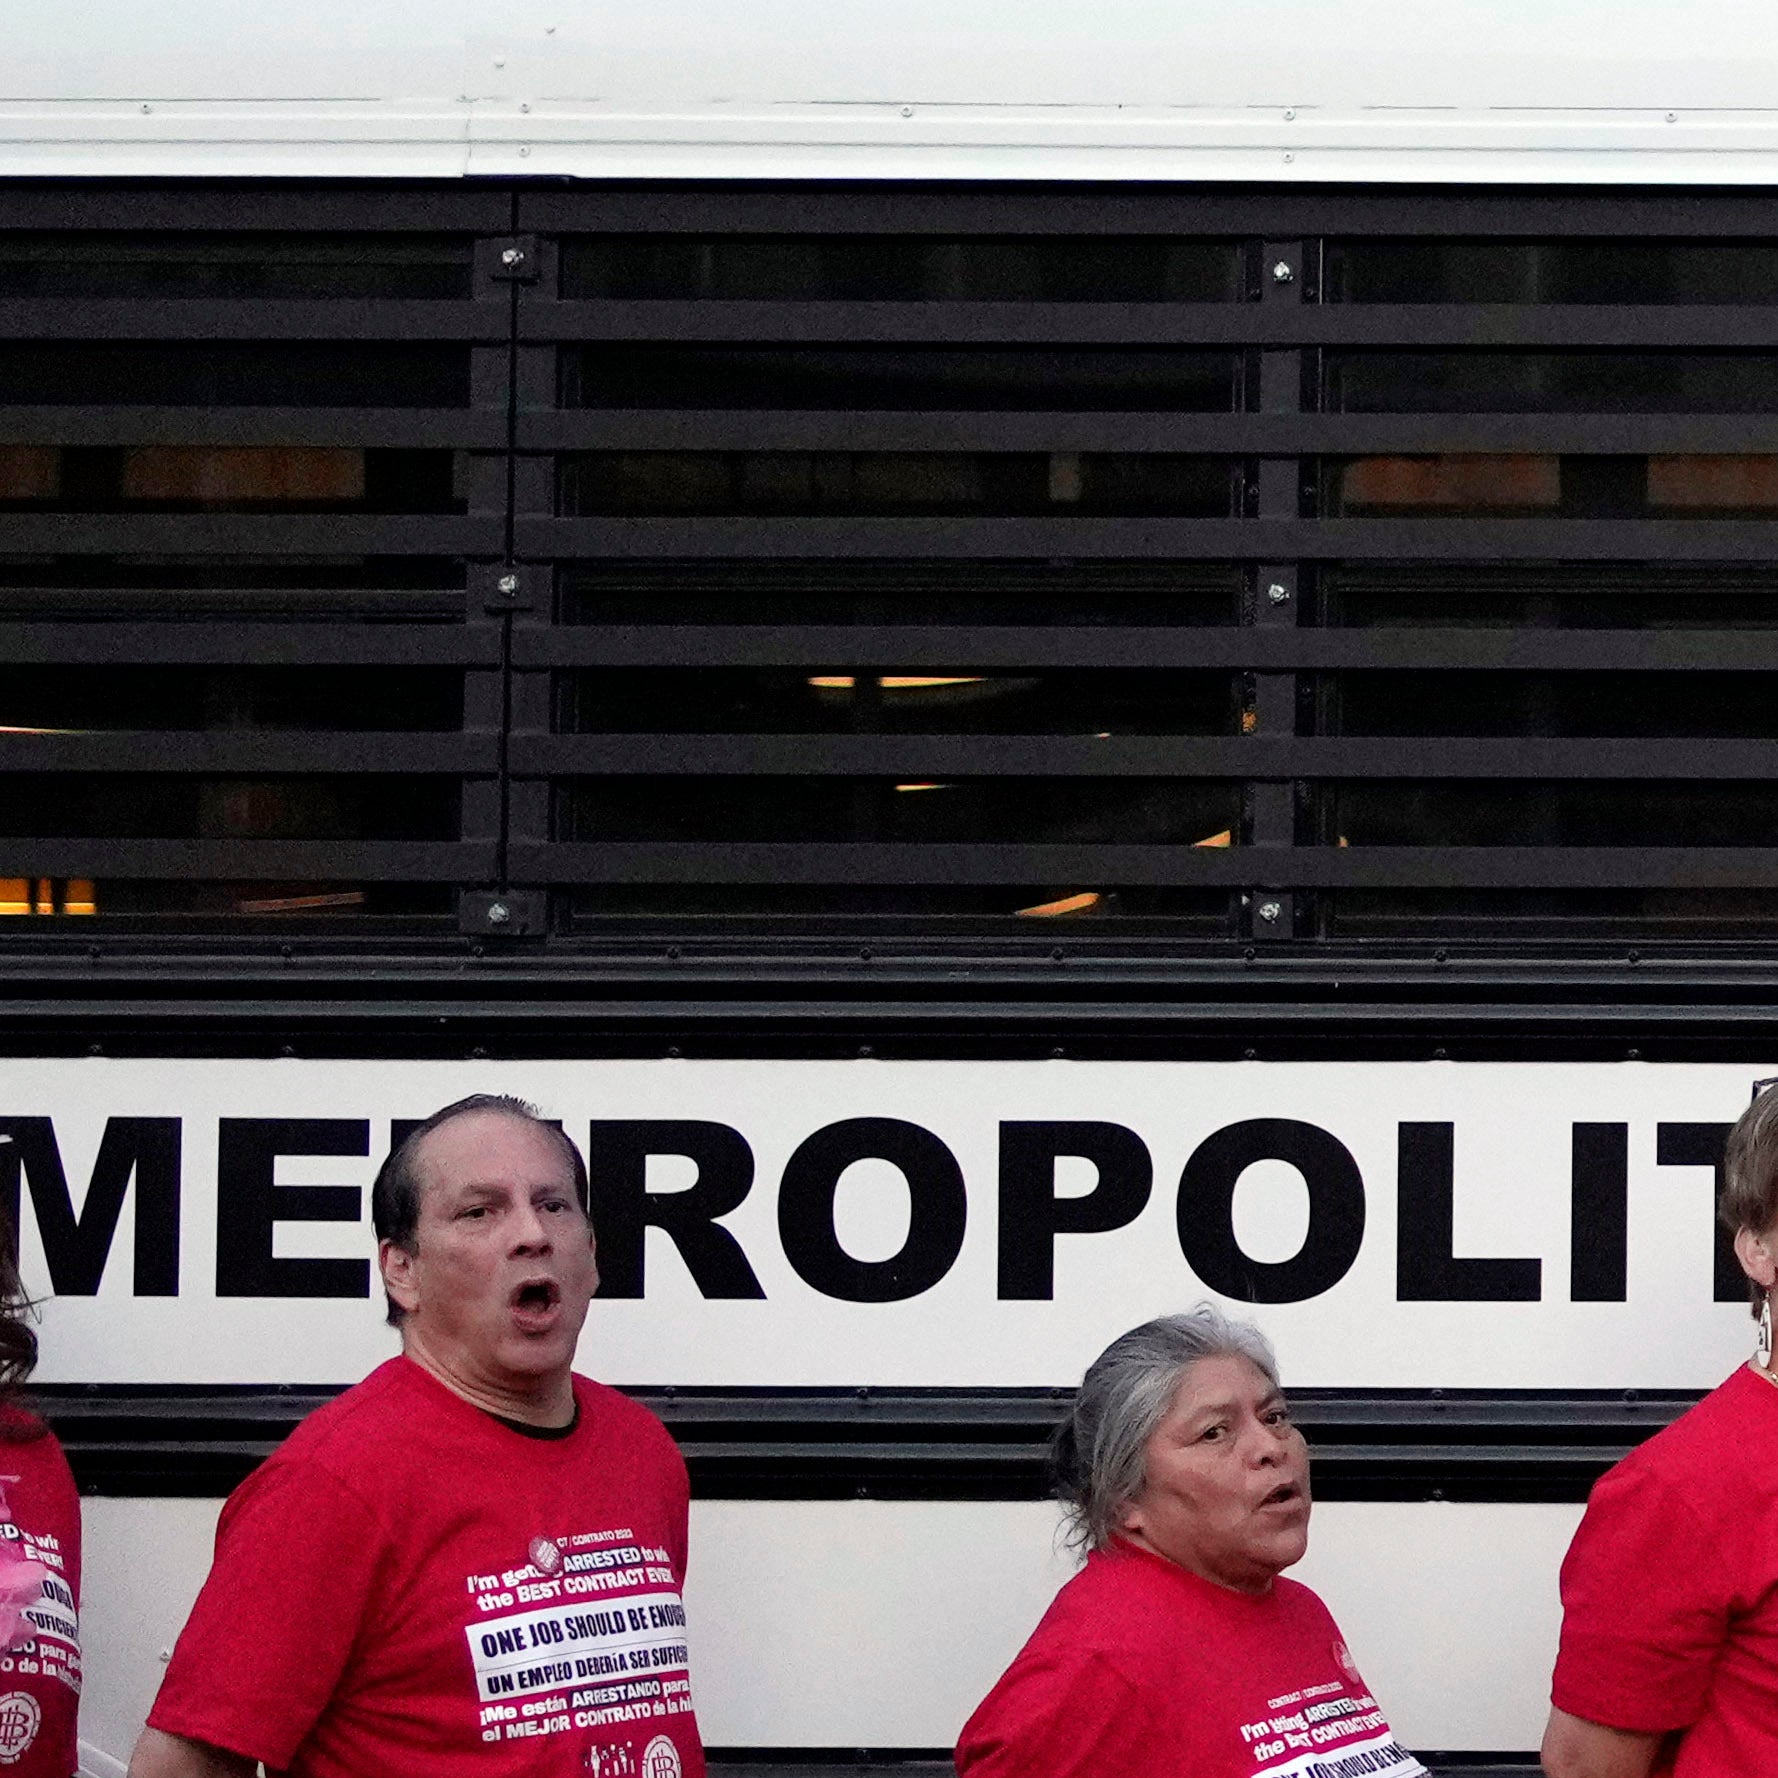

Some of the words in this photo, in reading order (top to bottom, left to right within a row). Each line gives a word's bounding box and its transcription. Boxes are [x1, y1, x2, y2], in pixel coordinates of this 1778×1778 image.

[467, 1574, 499, 1593] I'm
[563, 1547, 642, 1573] ARRESTED
[476, 1592, 514, 1611] the
[516, 1579, 561, 1603] BEST
[564, 1567, 646, 1594] CONTRACT
[39, 1643, 66, 1662] para
[481, 1627, 527, 1658] ONE
[528, 1619, 564, 1648] JOB
[565, 1611, 626, 1640] SHOULD
[629, 1607, 649, 1627] BE
[19, 1658, 38, 1674] de
[43, 1660, 56, 1676] la
[487, 1674, 515, 1694] UN
[518, 1661, 572, 1691] EMPLEO
[631, 1650, 651, 1670] SER
[480, 1705, 517, 1726] ¡Me
[522, 1695, 568, 1716] están
[572, 1680, 662, 1707] ARRESTANDO
[481, 1725, 500, 1742] el
[506, 1717, 570, 1739] MEJOR
[575, 1704, 651, 1728] CONTRATO
[653, 1700, 666, 1716] de
[667, 1698, 679, 1714] la
[1240, 1720, 1270, 1742] I'm
[1253, 1740, 1285, 1761] the
